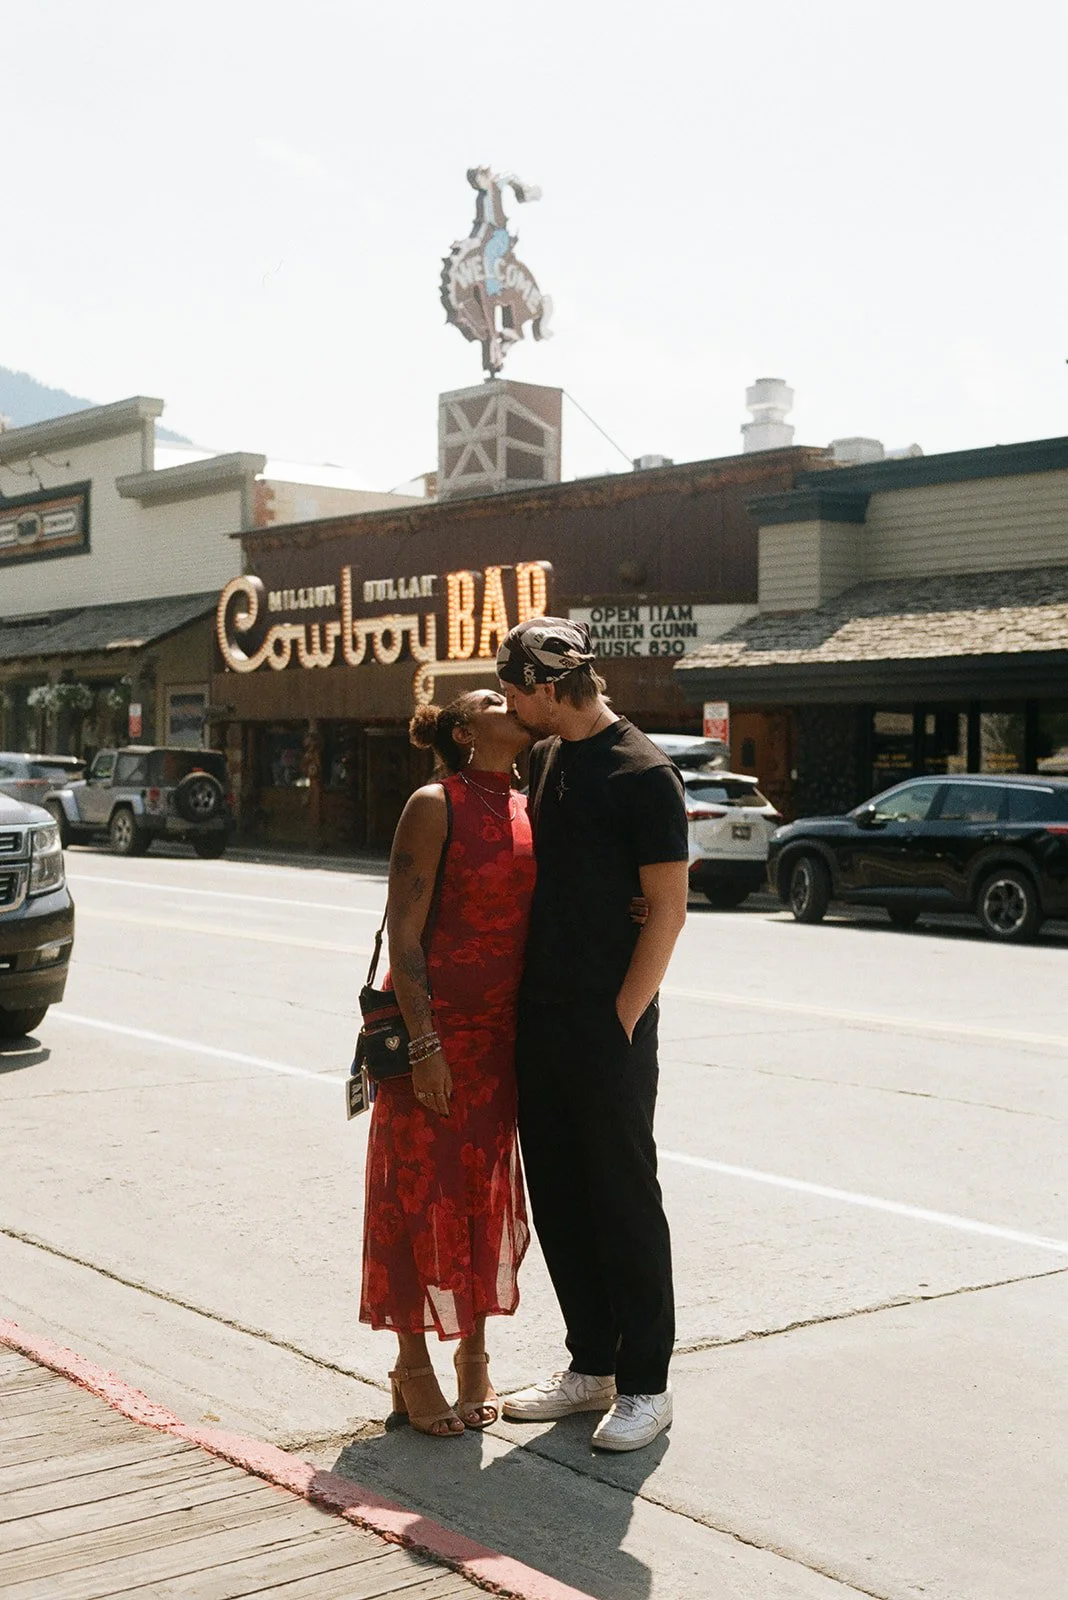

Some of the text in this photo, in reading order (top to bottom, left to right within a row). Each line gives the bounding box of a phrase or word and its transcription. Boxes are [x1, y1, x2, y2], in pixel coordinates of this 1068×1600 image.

[446, 560, 554, 660] BAR
[590, 606, 640, 622] OPEN
[590, 622, 697, 639] AMIEN GUNN
[648, 640, 685, 655] 830
